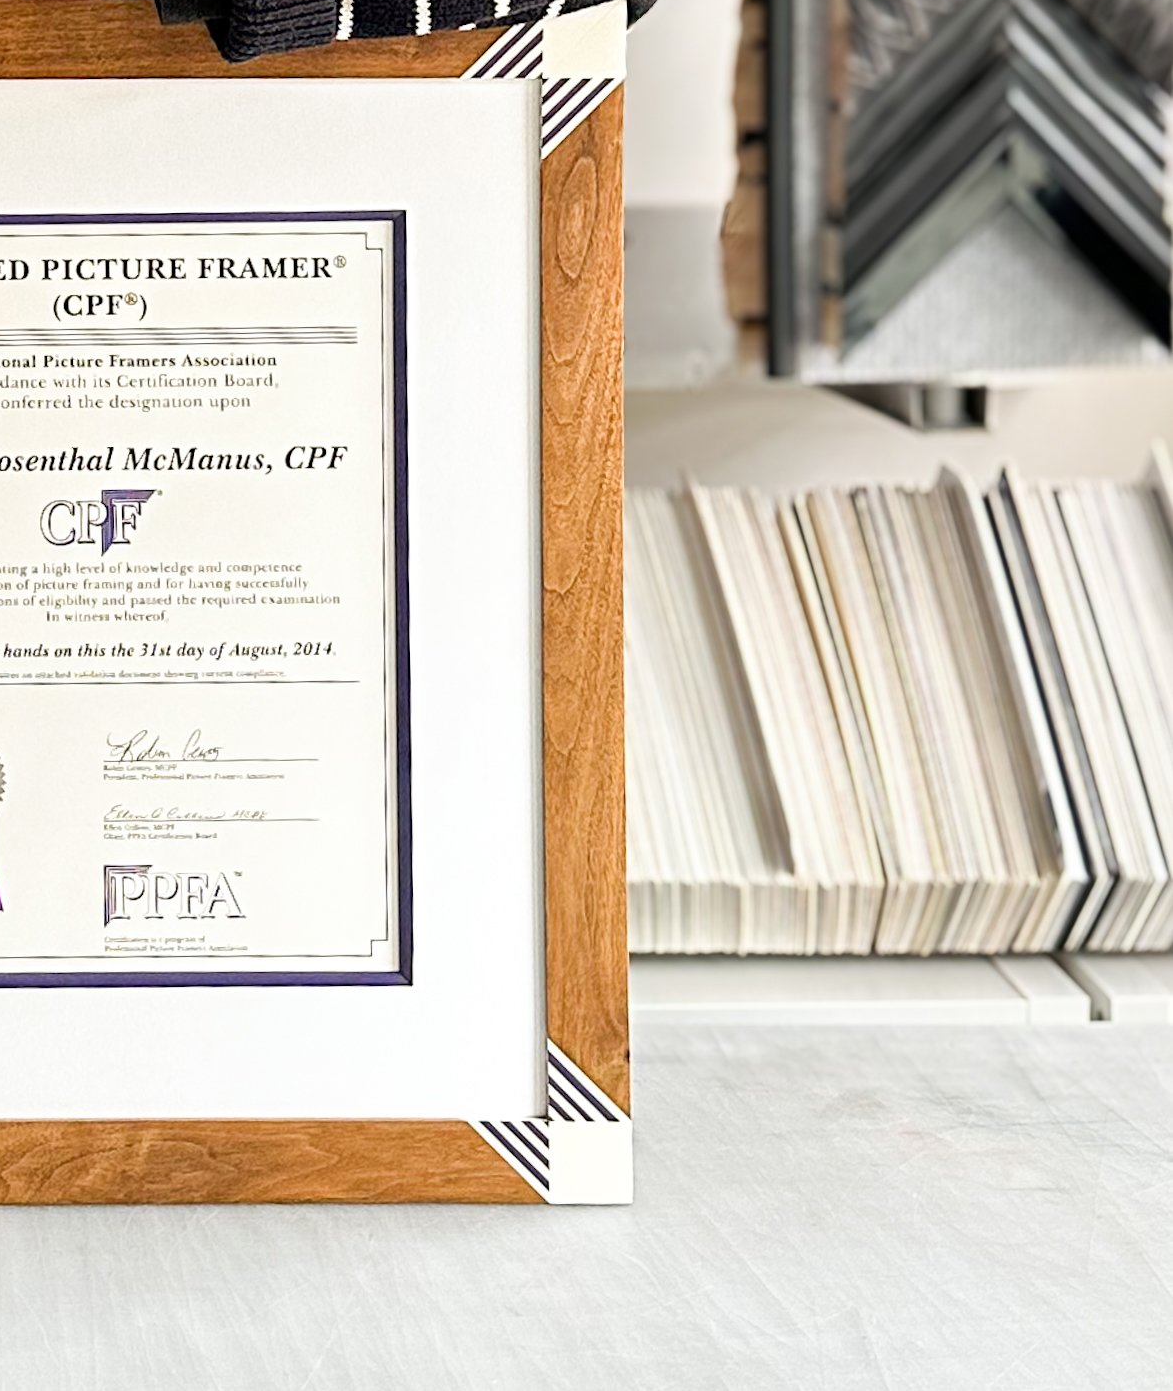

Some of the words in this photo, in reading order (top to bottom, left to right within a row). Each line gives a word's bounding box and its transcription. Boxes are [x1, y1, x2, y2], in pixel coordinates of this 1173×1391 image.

[42, 258, 186, 280] PICTURE
[43, 355, 103, 367] Picture
[109, 355, 175, 367] Framers
[182, 354, 277, 367] Association
[53, 375, 86, 388] with
[93, 375, 111, 388] its
[117, 374, 217, 388] Certification
[79, 395, 102, 408] the
[109, 395, 202, 412] designation
[210, 398, 250, 412] upon
[122, 447, 272, 474] McManus,
[285, 446, 348, 469] CPF
[40, 499, 142, 546] CPF
[32, 566, 38, 574] a
[43, 563, 71, 577] high
[76, 562, 104, 574] level
[109, 562, 122, 573] of
[126, 562, 193, 576] knowledge
[198, 562, 221, 573] and
[227, 563, 303, 576] competence
[16, 579, 30, 590] of
[33, 579, 78, 593] picture
[84, 579, 133, 592] framing
[137, 578, 160, 589] and
[166, 577, 184, 589] for
[189, 578, 231, 592] having
[236, 576, 308, 591] successfully
[23, 595, 36, 606] of
[39, 595, 98, 609] eligibility
[102, 594, 126, 606] and
[130, 594, 172, 608] passed
[177, 594, 196, 605] the
[202, 594, 256, 608] required
[261, 593, 341, 605] examination
[47, 611, 60, 622] In
[65, 611, 110, 622] witness
[4, 643, 49, 657] hands
[54, 648, 72, 657] on
[78, 644, 105, 657] this
[112, 643, 134, 657] the
[140, 643, 171, 656] 31st
[177, 642, 204, 661] day
[210, 642, 226, 660] of
[229, 643, 287, 661] August,
